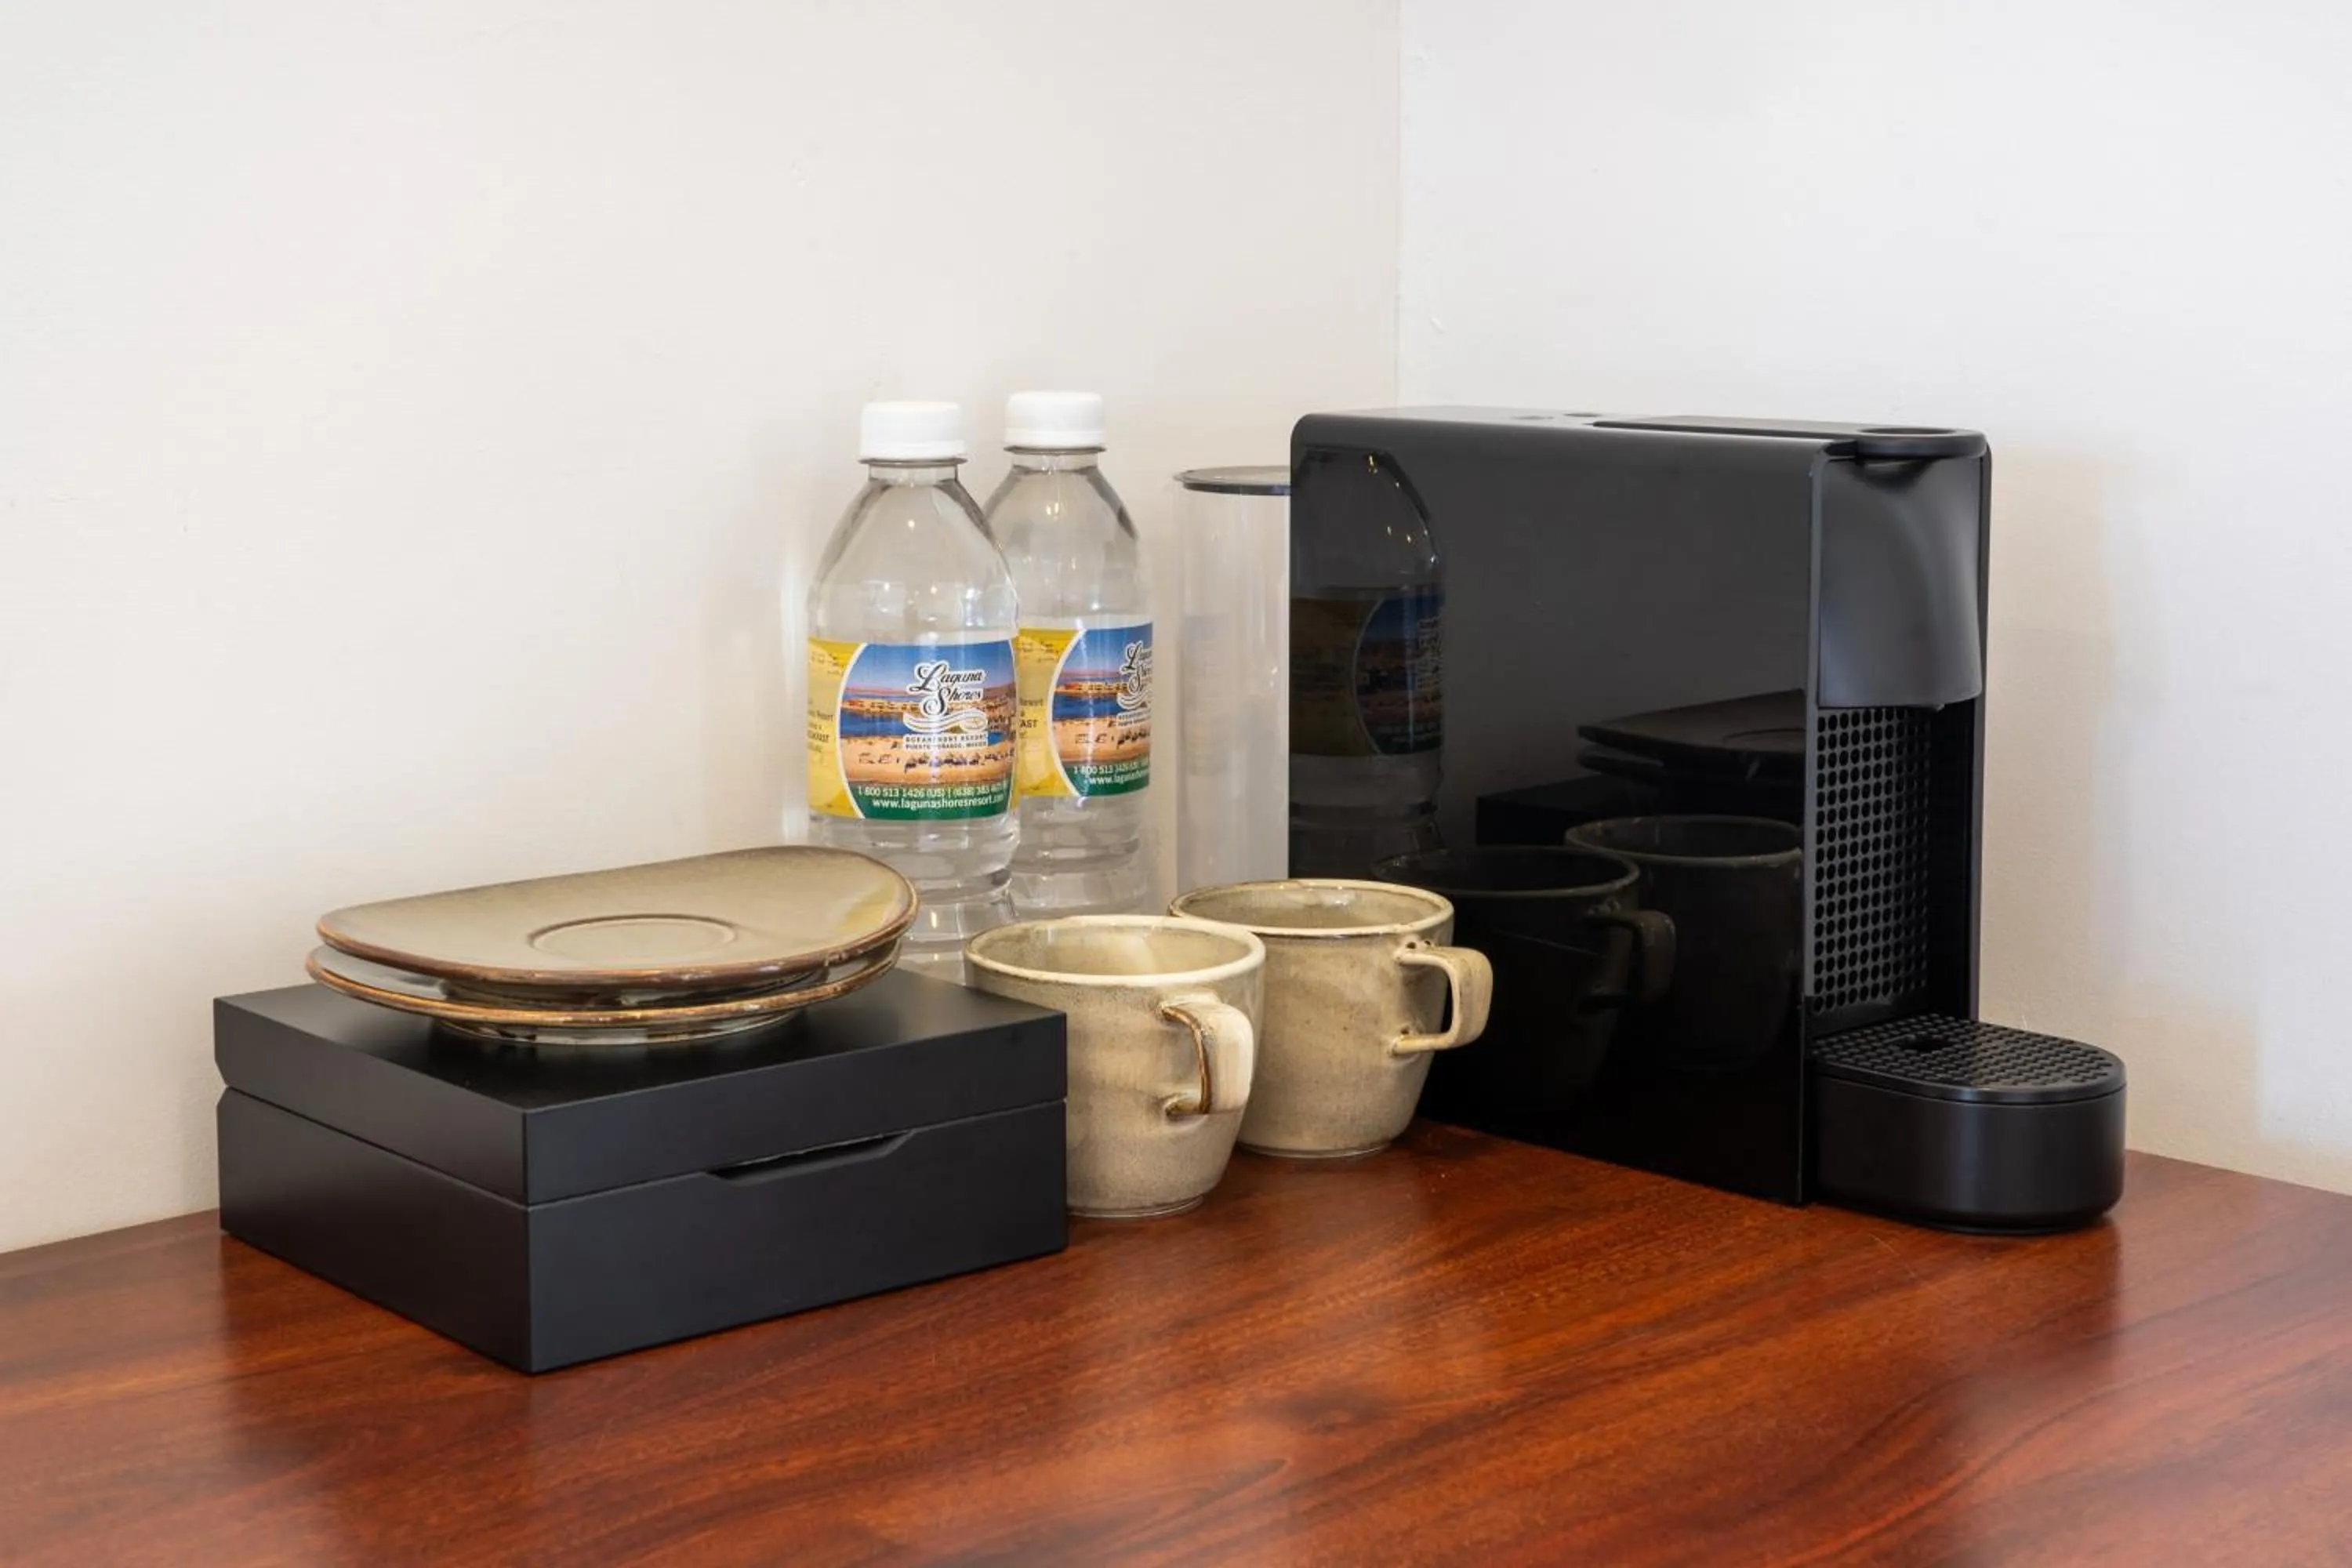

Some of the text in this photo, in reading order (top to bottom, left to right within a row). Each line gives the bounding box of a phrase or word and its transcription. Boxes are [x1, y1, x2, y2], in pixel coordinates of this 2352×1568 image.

[909, 664, 983, 691] Laguna
[923, 687, 982, 715] Shores
[1018, 719, 1038, 728] AST
[858, 786, 862, 796] 1
[865, 786, 880, 797] 800
[883, 787, 899, 797] 513
[902, 787, 925, 797] 1426
